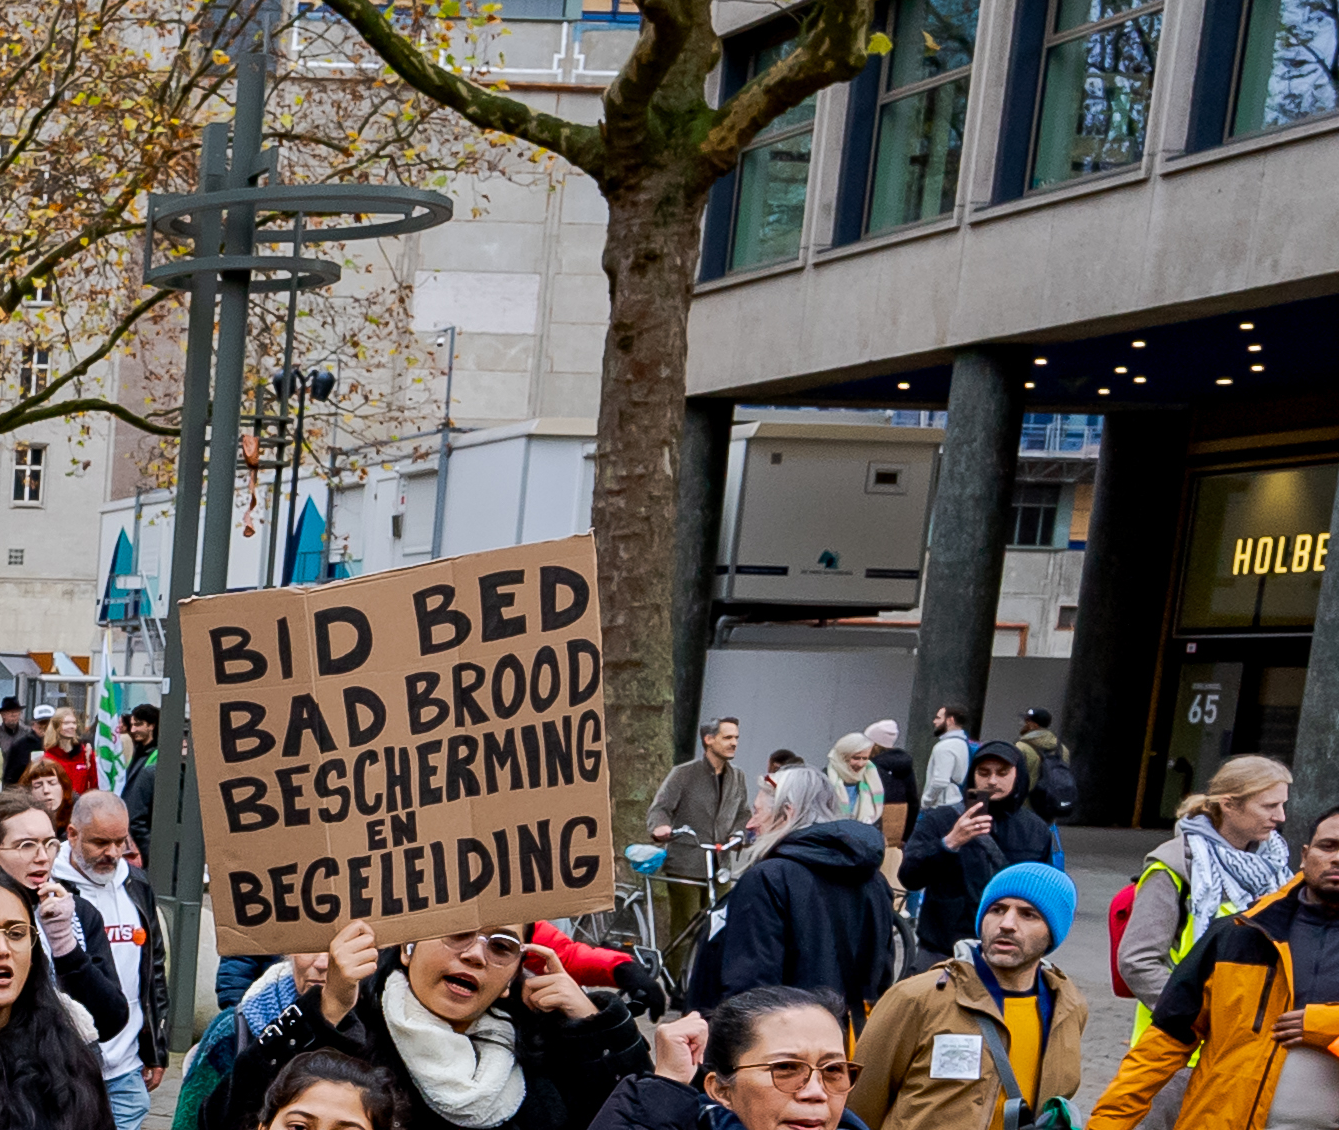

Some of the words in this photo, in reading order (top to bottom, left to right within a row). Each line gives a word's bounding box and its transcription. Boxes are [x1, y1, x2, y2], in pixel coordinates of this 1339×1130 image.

[209, 605, 372, 685] BID
[412, 565, 590, 656] BED
[219, 686, 386, 763] BAD
[405, 638, 601, 735] BROOD
[1188, 694, 1219, 724] 65
[219, 708, 602, 834] BESCHERMING
[228, 815, 600, 927] BEGELEIDING
[366, 810, 418, 852] EN
